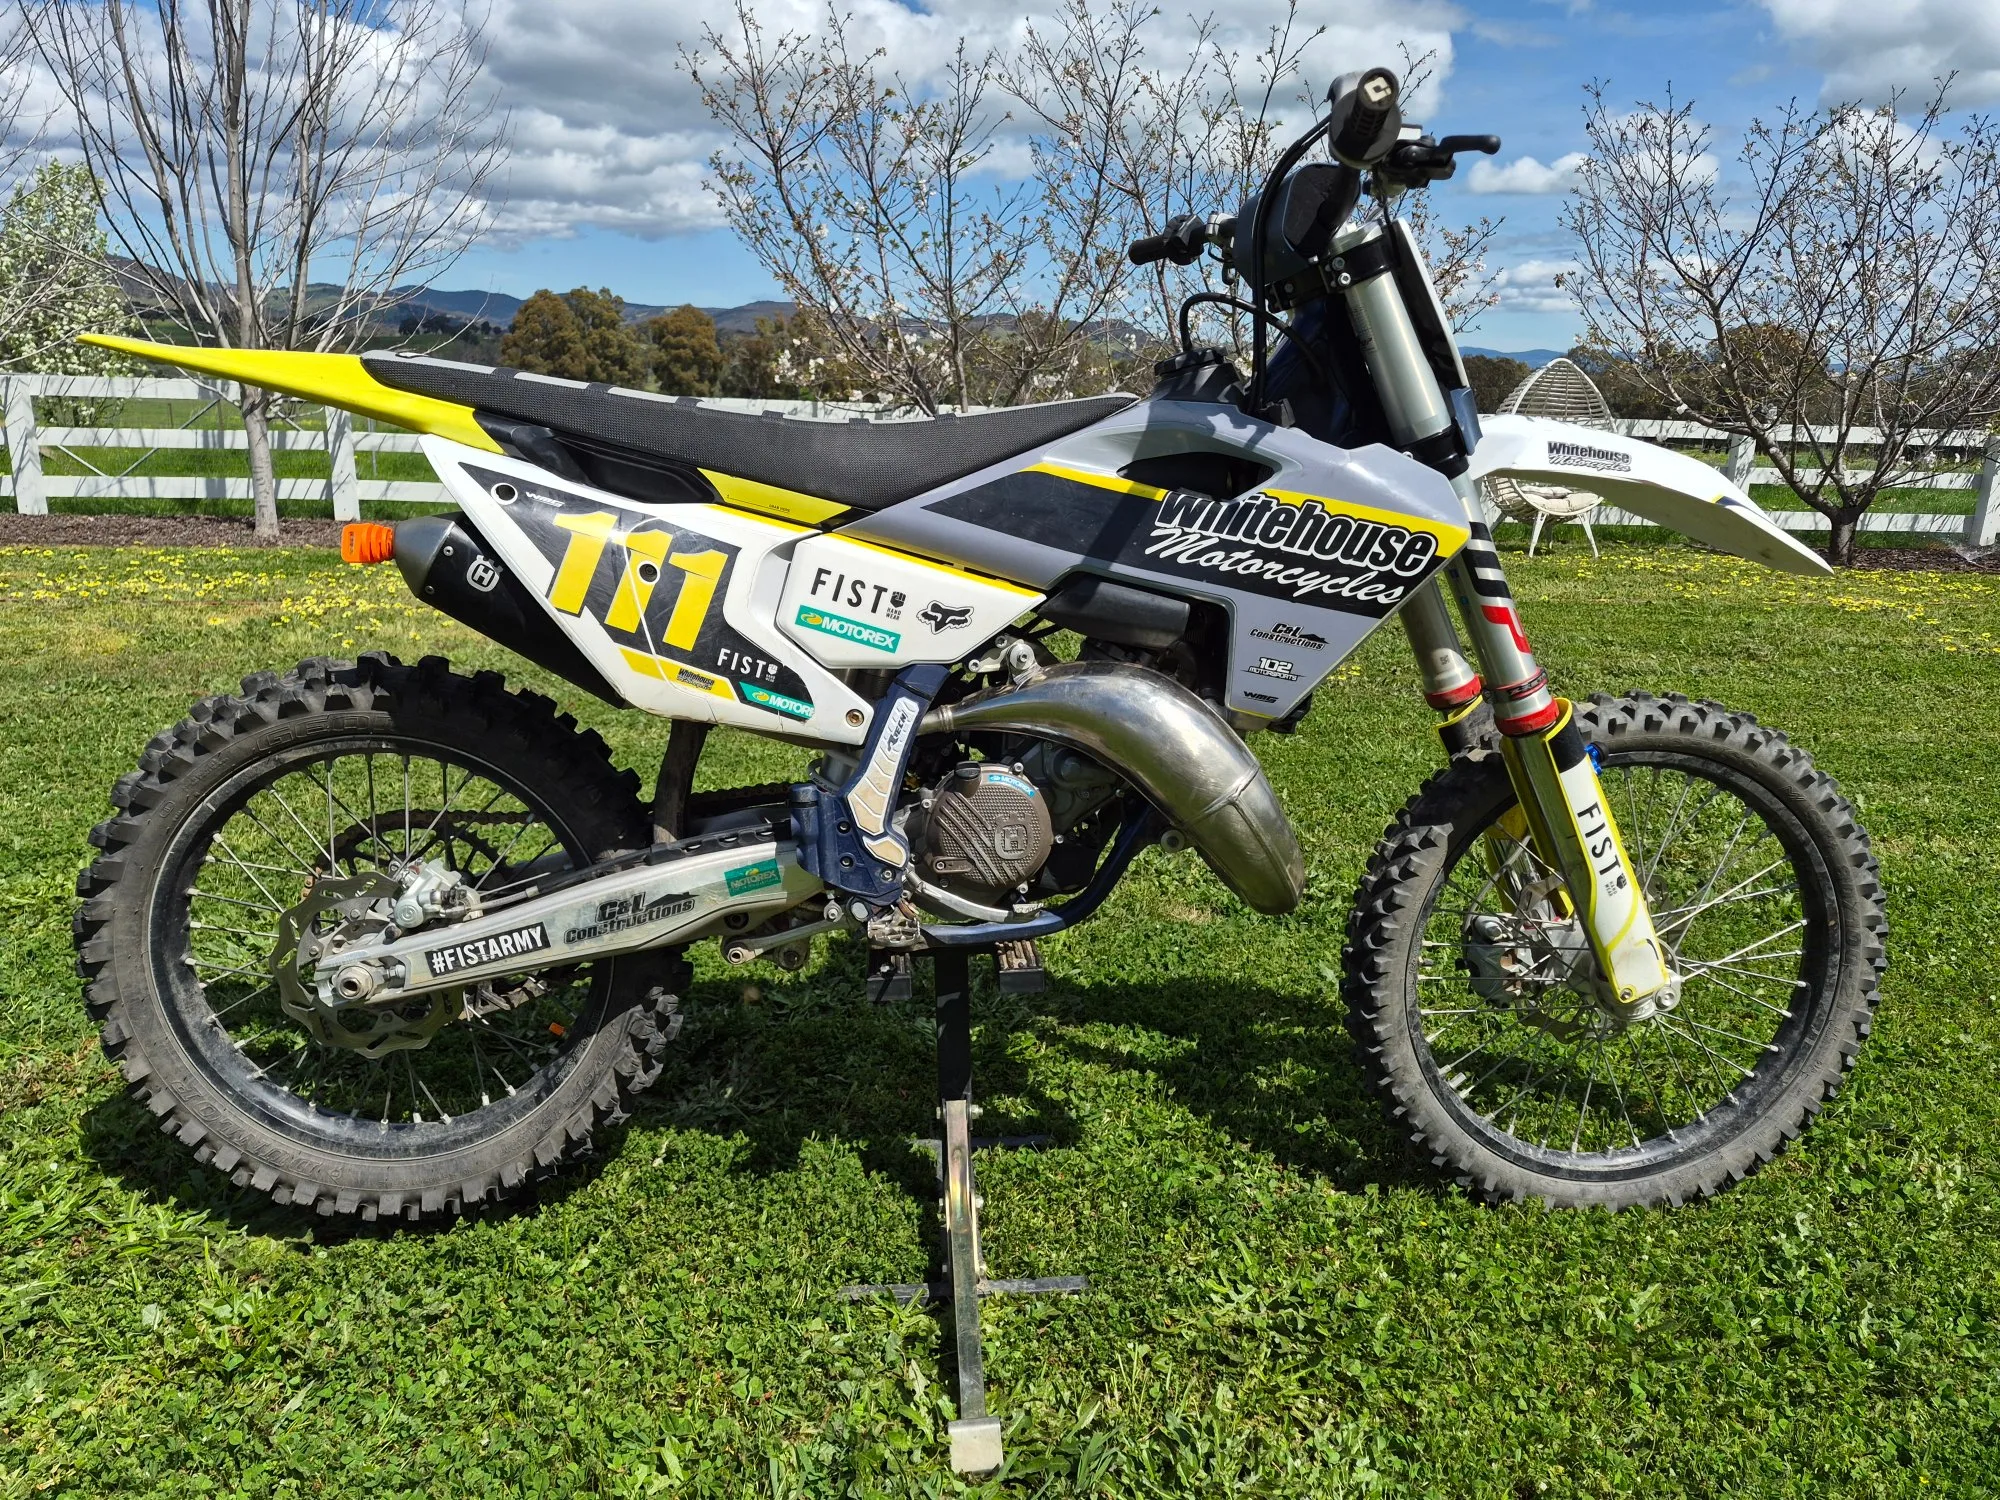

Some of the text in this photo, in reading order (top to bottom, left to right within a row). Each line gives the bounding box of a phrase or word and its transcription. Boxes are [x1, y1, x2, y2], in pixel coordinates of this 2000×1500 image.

[1547, 440, 1632, 464] Whitehouse
[1548, 454, 1632, 472] Motorcycles
[1154, 490, 1438, 577] Whitehouse
[1145, 526, 1405, 604] Motorcycles
[548, 510, 729, 652] 111
[810, 567, 889, 615] FIST
[887, 606, 902, 616] HAND
[821, 615, 897, 650] MOTOREX
[1249, 628, 1325, 651] Constructions
[1271, 622, 1304, 638] C&L
[717, 648, 767, 679] FIST
[1248, 666, 1299, 681] MOTORSPORTS
[1259, 657, 1293, 674] 102
[1001, 775, 1032, 796] MOTOREX
[1577, 801, 1621, 876] FIST
[730, 869, 777, 890] MOTOREX
[563, 898, 696, 945] Constructions
[596, 892, 651, 921] C&L
[431, 925, 546, 974] #FISTARMY
[170, 1078, 324, 1177] DUNLOP
